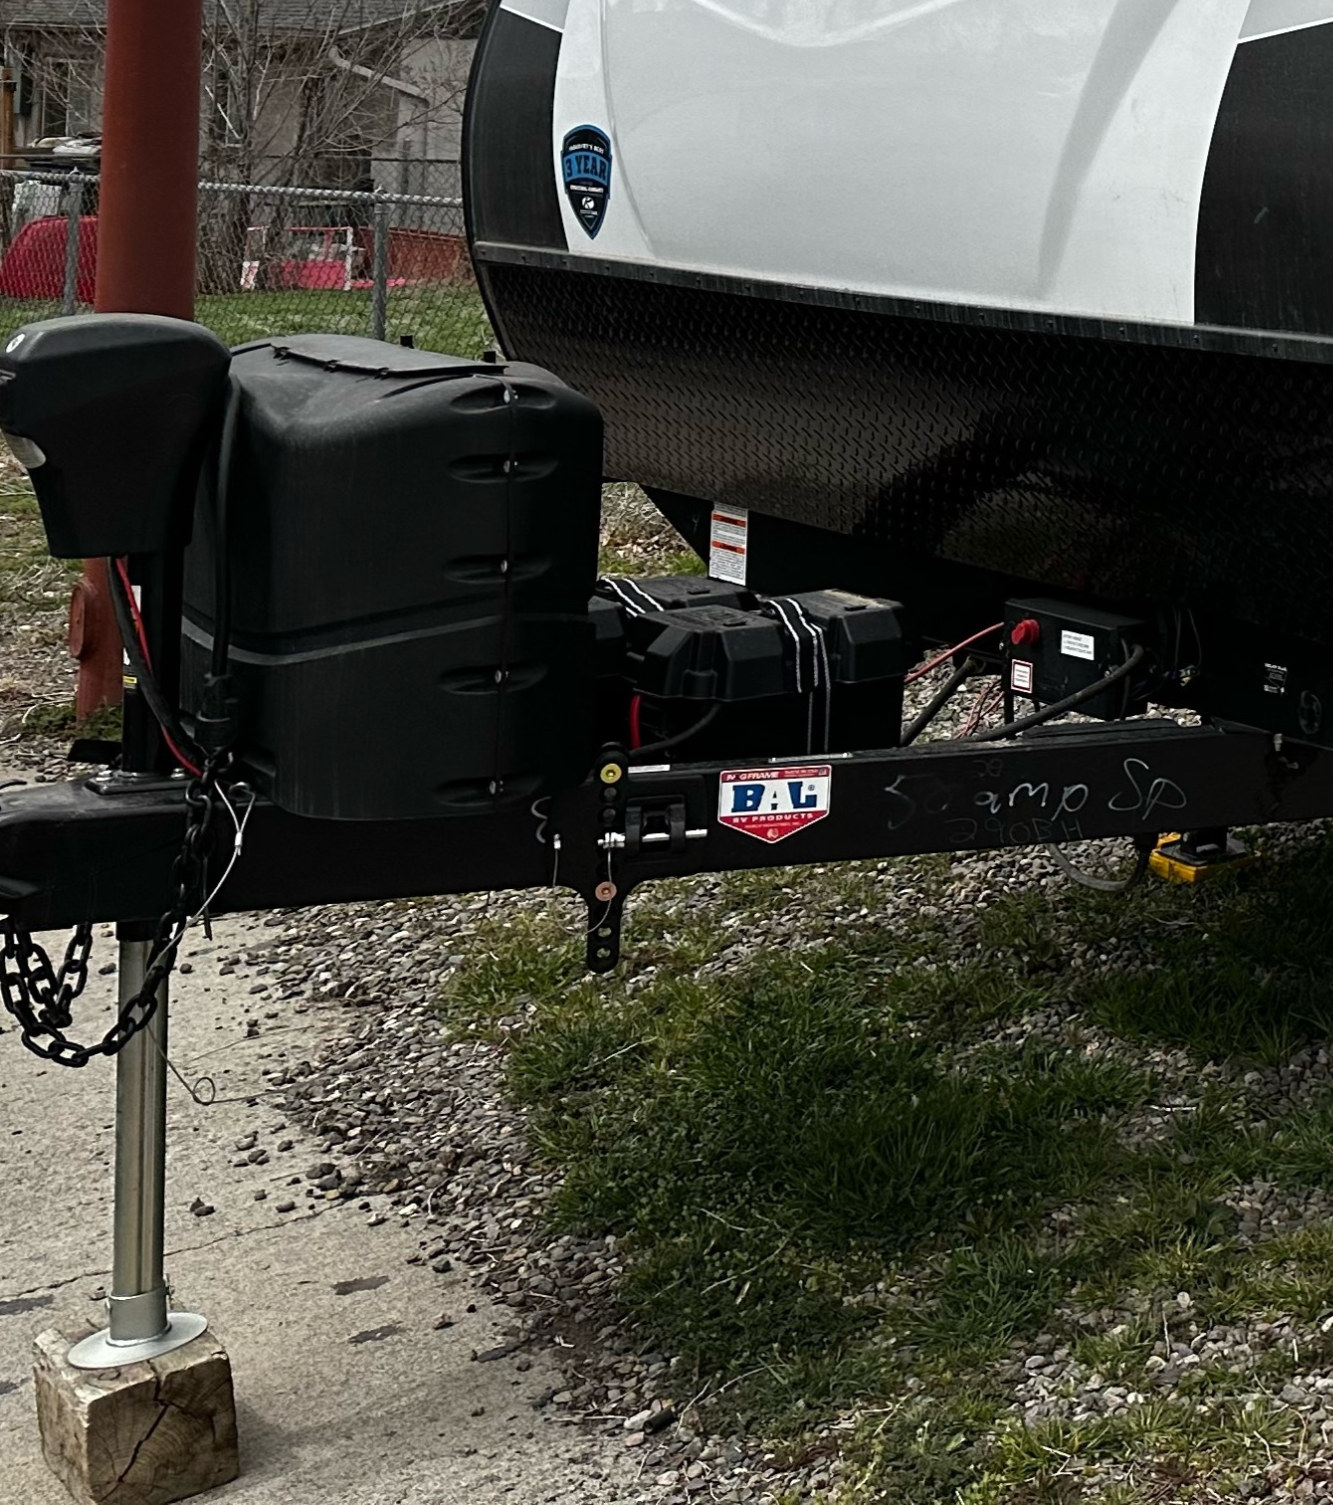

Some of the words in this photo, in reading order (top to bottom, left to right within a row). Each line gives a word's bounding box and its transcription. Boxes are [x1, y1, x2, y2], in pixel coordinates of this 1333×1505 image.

[565, 158, 574, 178] 3
[574, 154, 607, 181] YEAR
[731, 781, 818, 813] BAL
[974, 781, 1089, 822] amp
[751, 813, 814, 823] PRODUCTS
